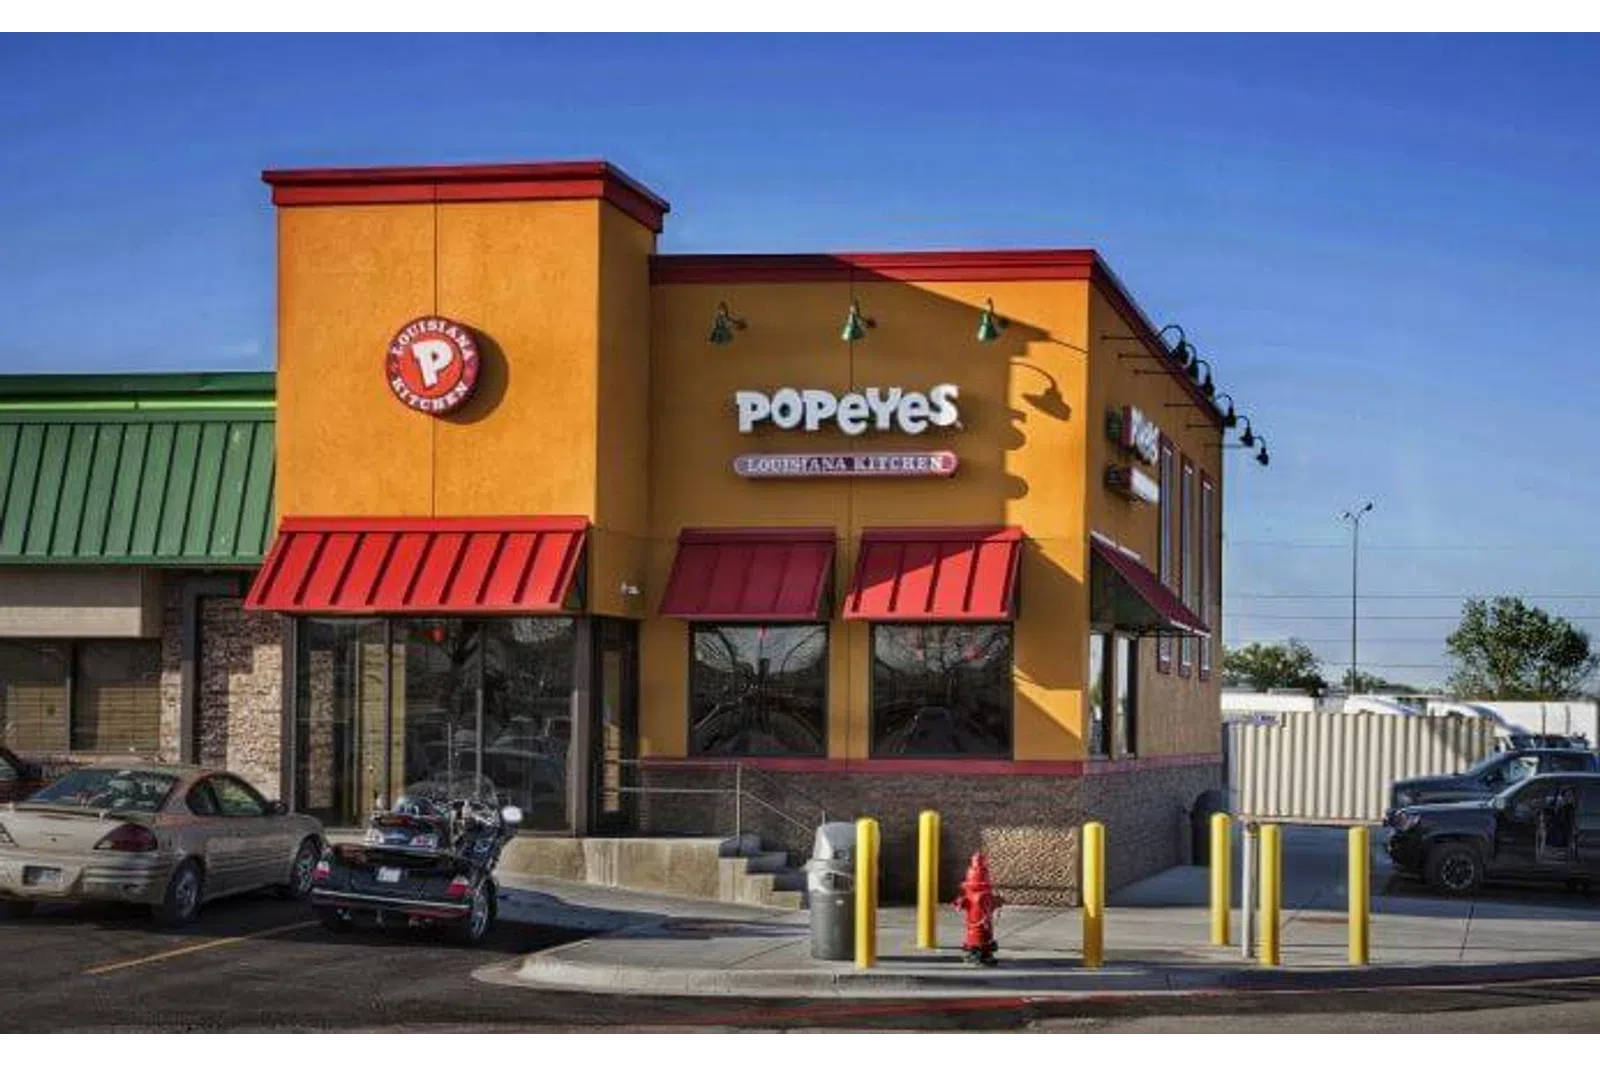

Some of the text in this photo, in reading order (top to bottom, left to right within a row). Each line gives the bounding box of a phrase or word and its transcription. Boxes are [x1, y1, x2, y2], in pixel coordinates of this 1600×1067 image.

[392, 320, 474, 361] LOUISIANA
[412, 340, 453, 388] P
[392, 378, 468, 411] KITCHEN
[747, 455, 944, 474] LOUISIANA KITCHEN
